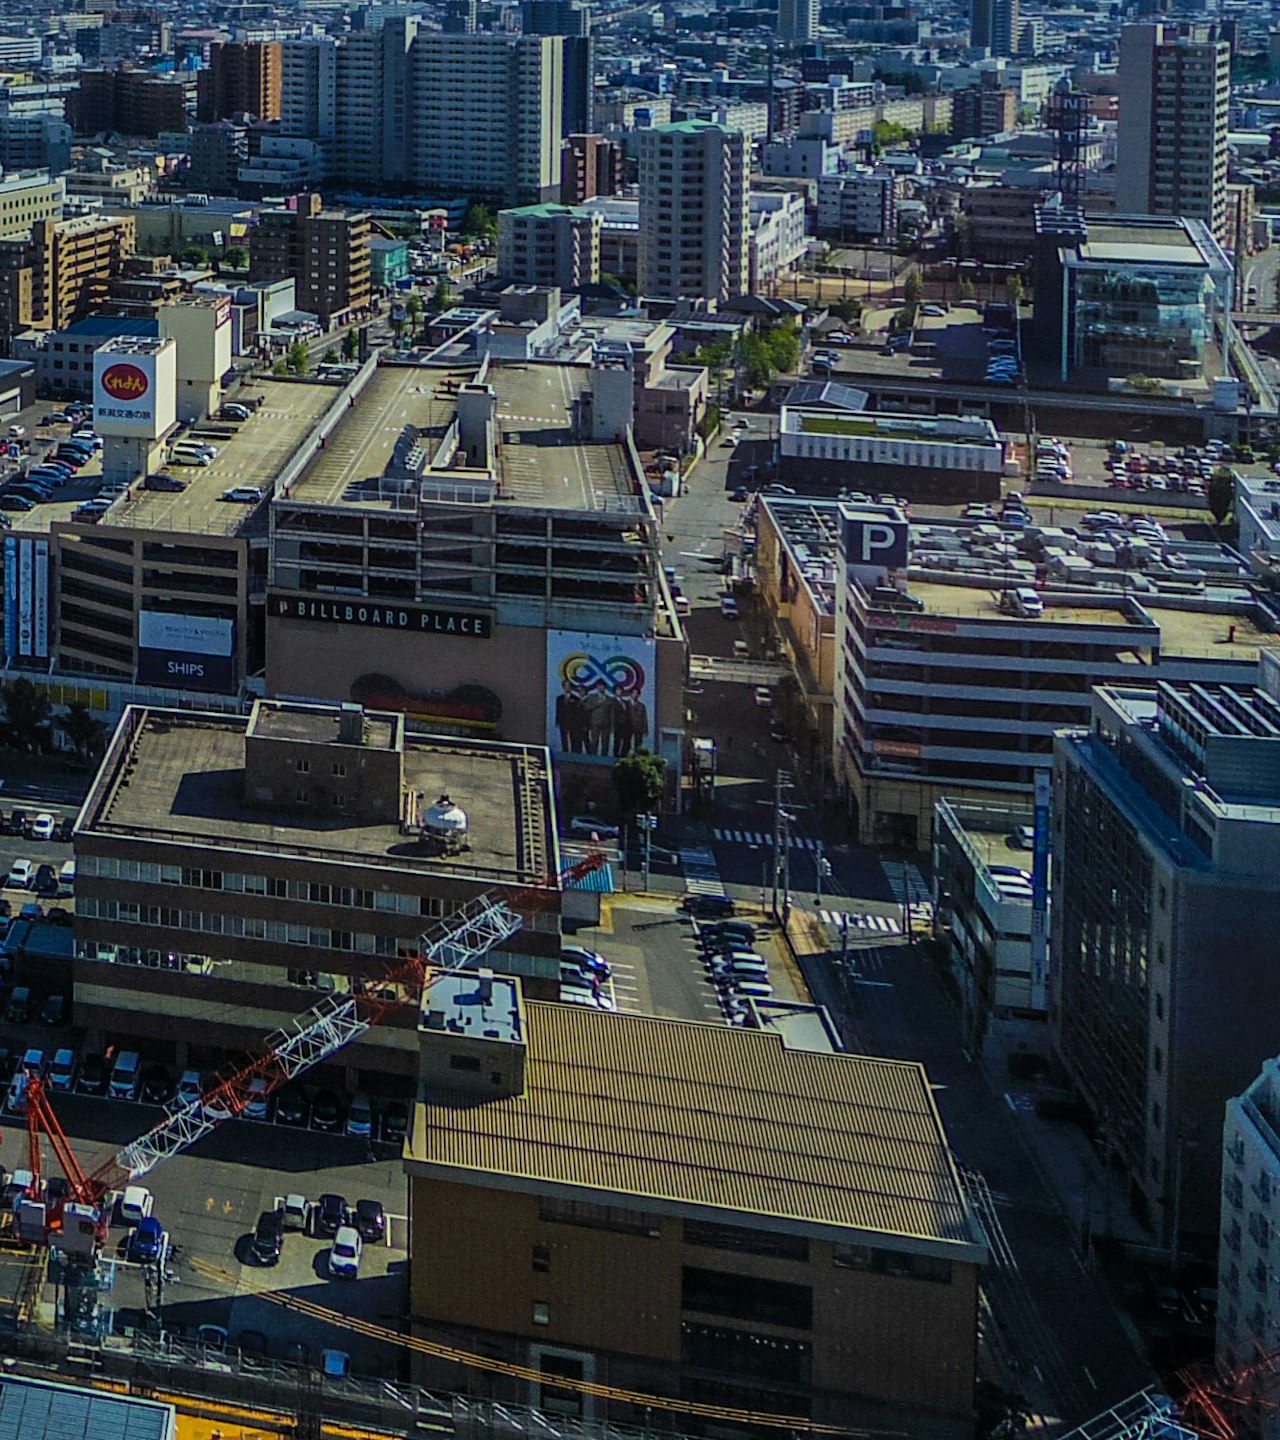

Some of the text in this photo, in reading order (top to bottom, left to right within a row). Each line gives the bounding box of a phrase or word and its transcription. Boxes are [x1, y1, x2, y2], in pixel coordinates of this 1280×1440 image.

[98, 408, 151, 419] 新潟交通の旅
[862, 523, 895, 561] P
[298, 601, 483, 634] BILLBOARD PLACE
[167, 661, 204, 677] SHIPS
